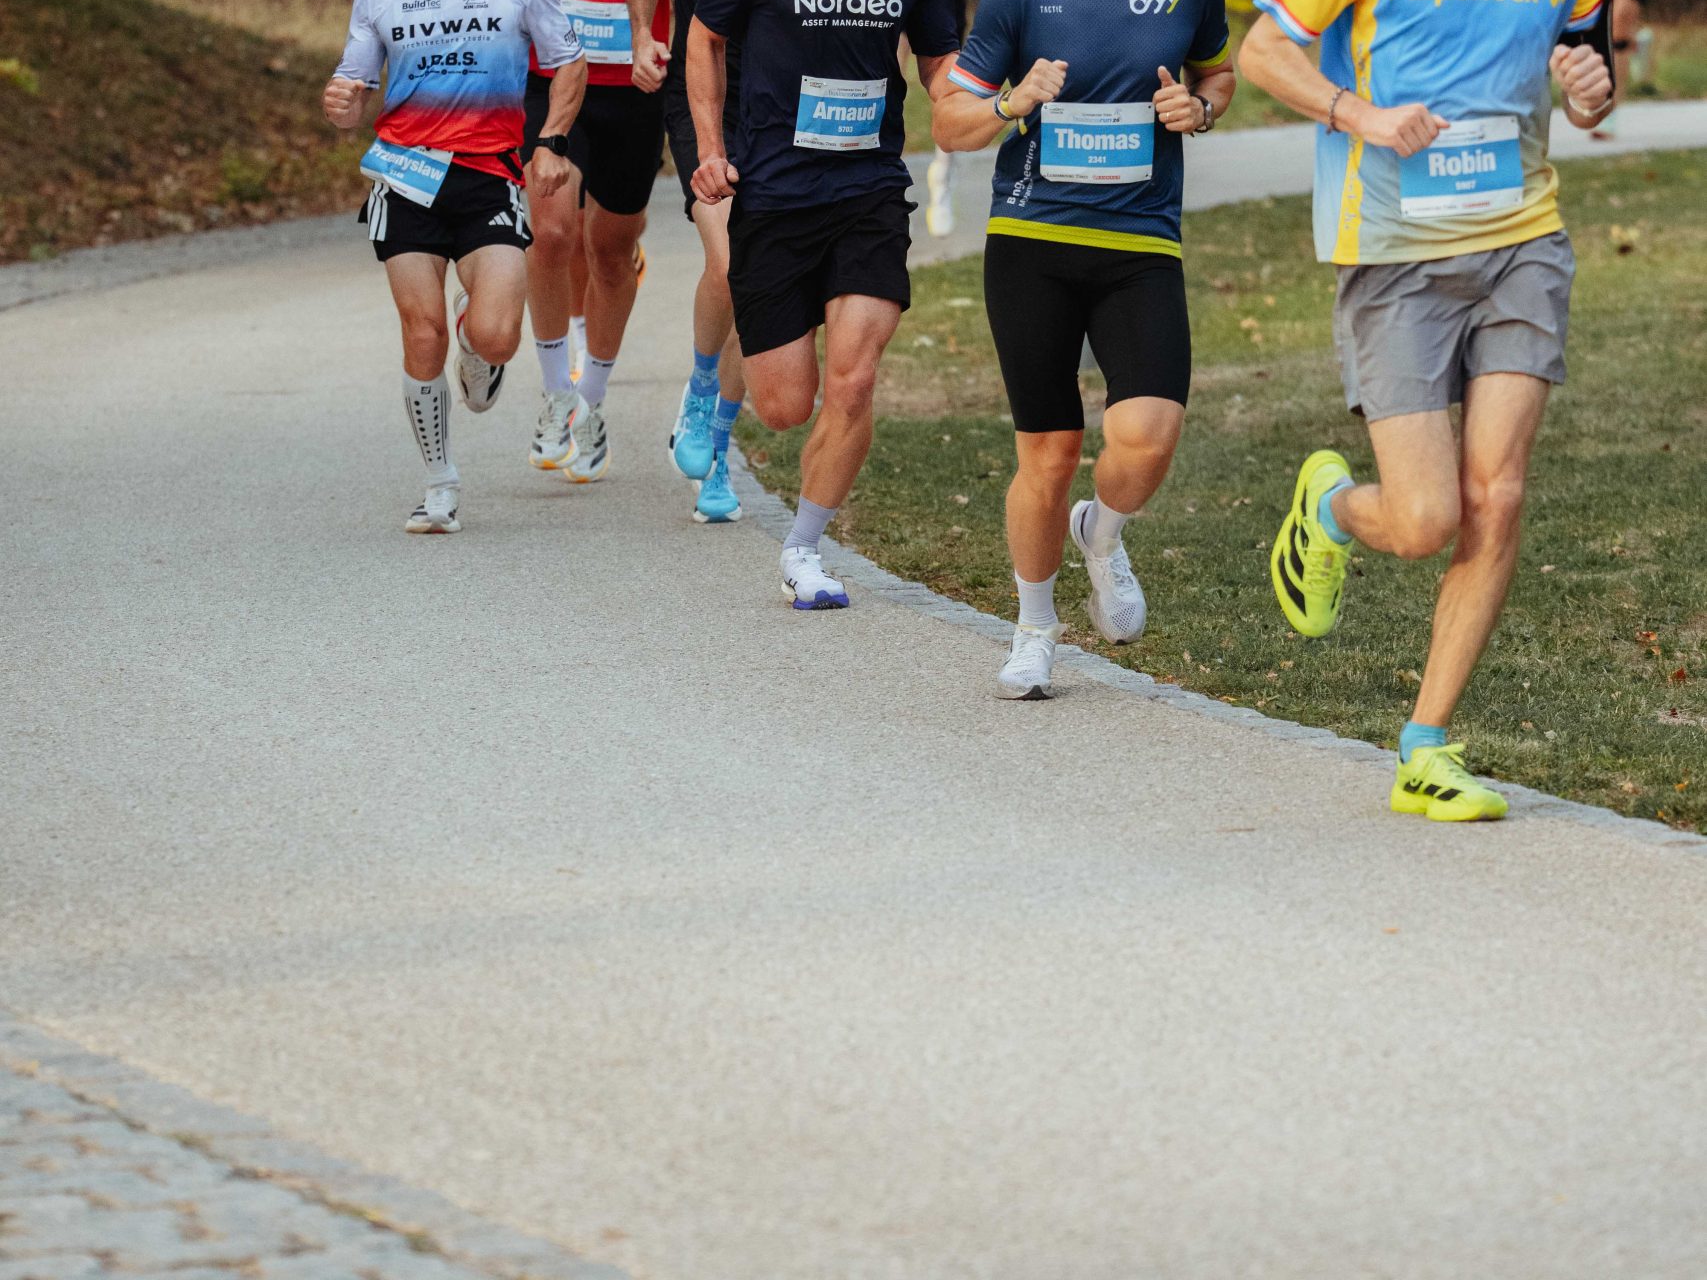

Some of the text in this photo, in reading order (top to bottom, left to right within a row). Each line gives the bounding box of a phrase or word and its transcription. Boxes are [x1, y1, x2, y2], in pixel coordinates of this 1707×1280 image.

[402, 0, 441, 10] BuildTec
[1040, 5, 1062, 13] TACTIC
[391, 17, 503, 42] BIVWAK
[573, 19, 614, 38] Benn
[802, 19, 895, 29] ASSET MANAGEMENT
[813, 101, 877, 121] Arnaud
[1054, 128, 1141, 151] Thomas
[1087, 155, 1107, 164] 2341
[1428, 148, 1497, 177] Robin
